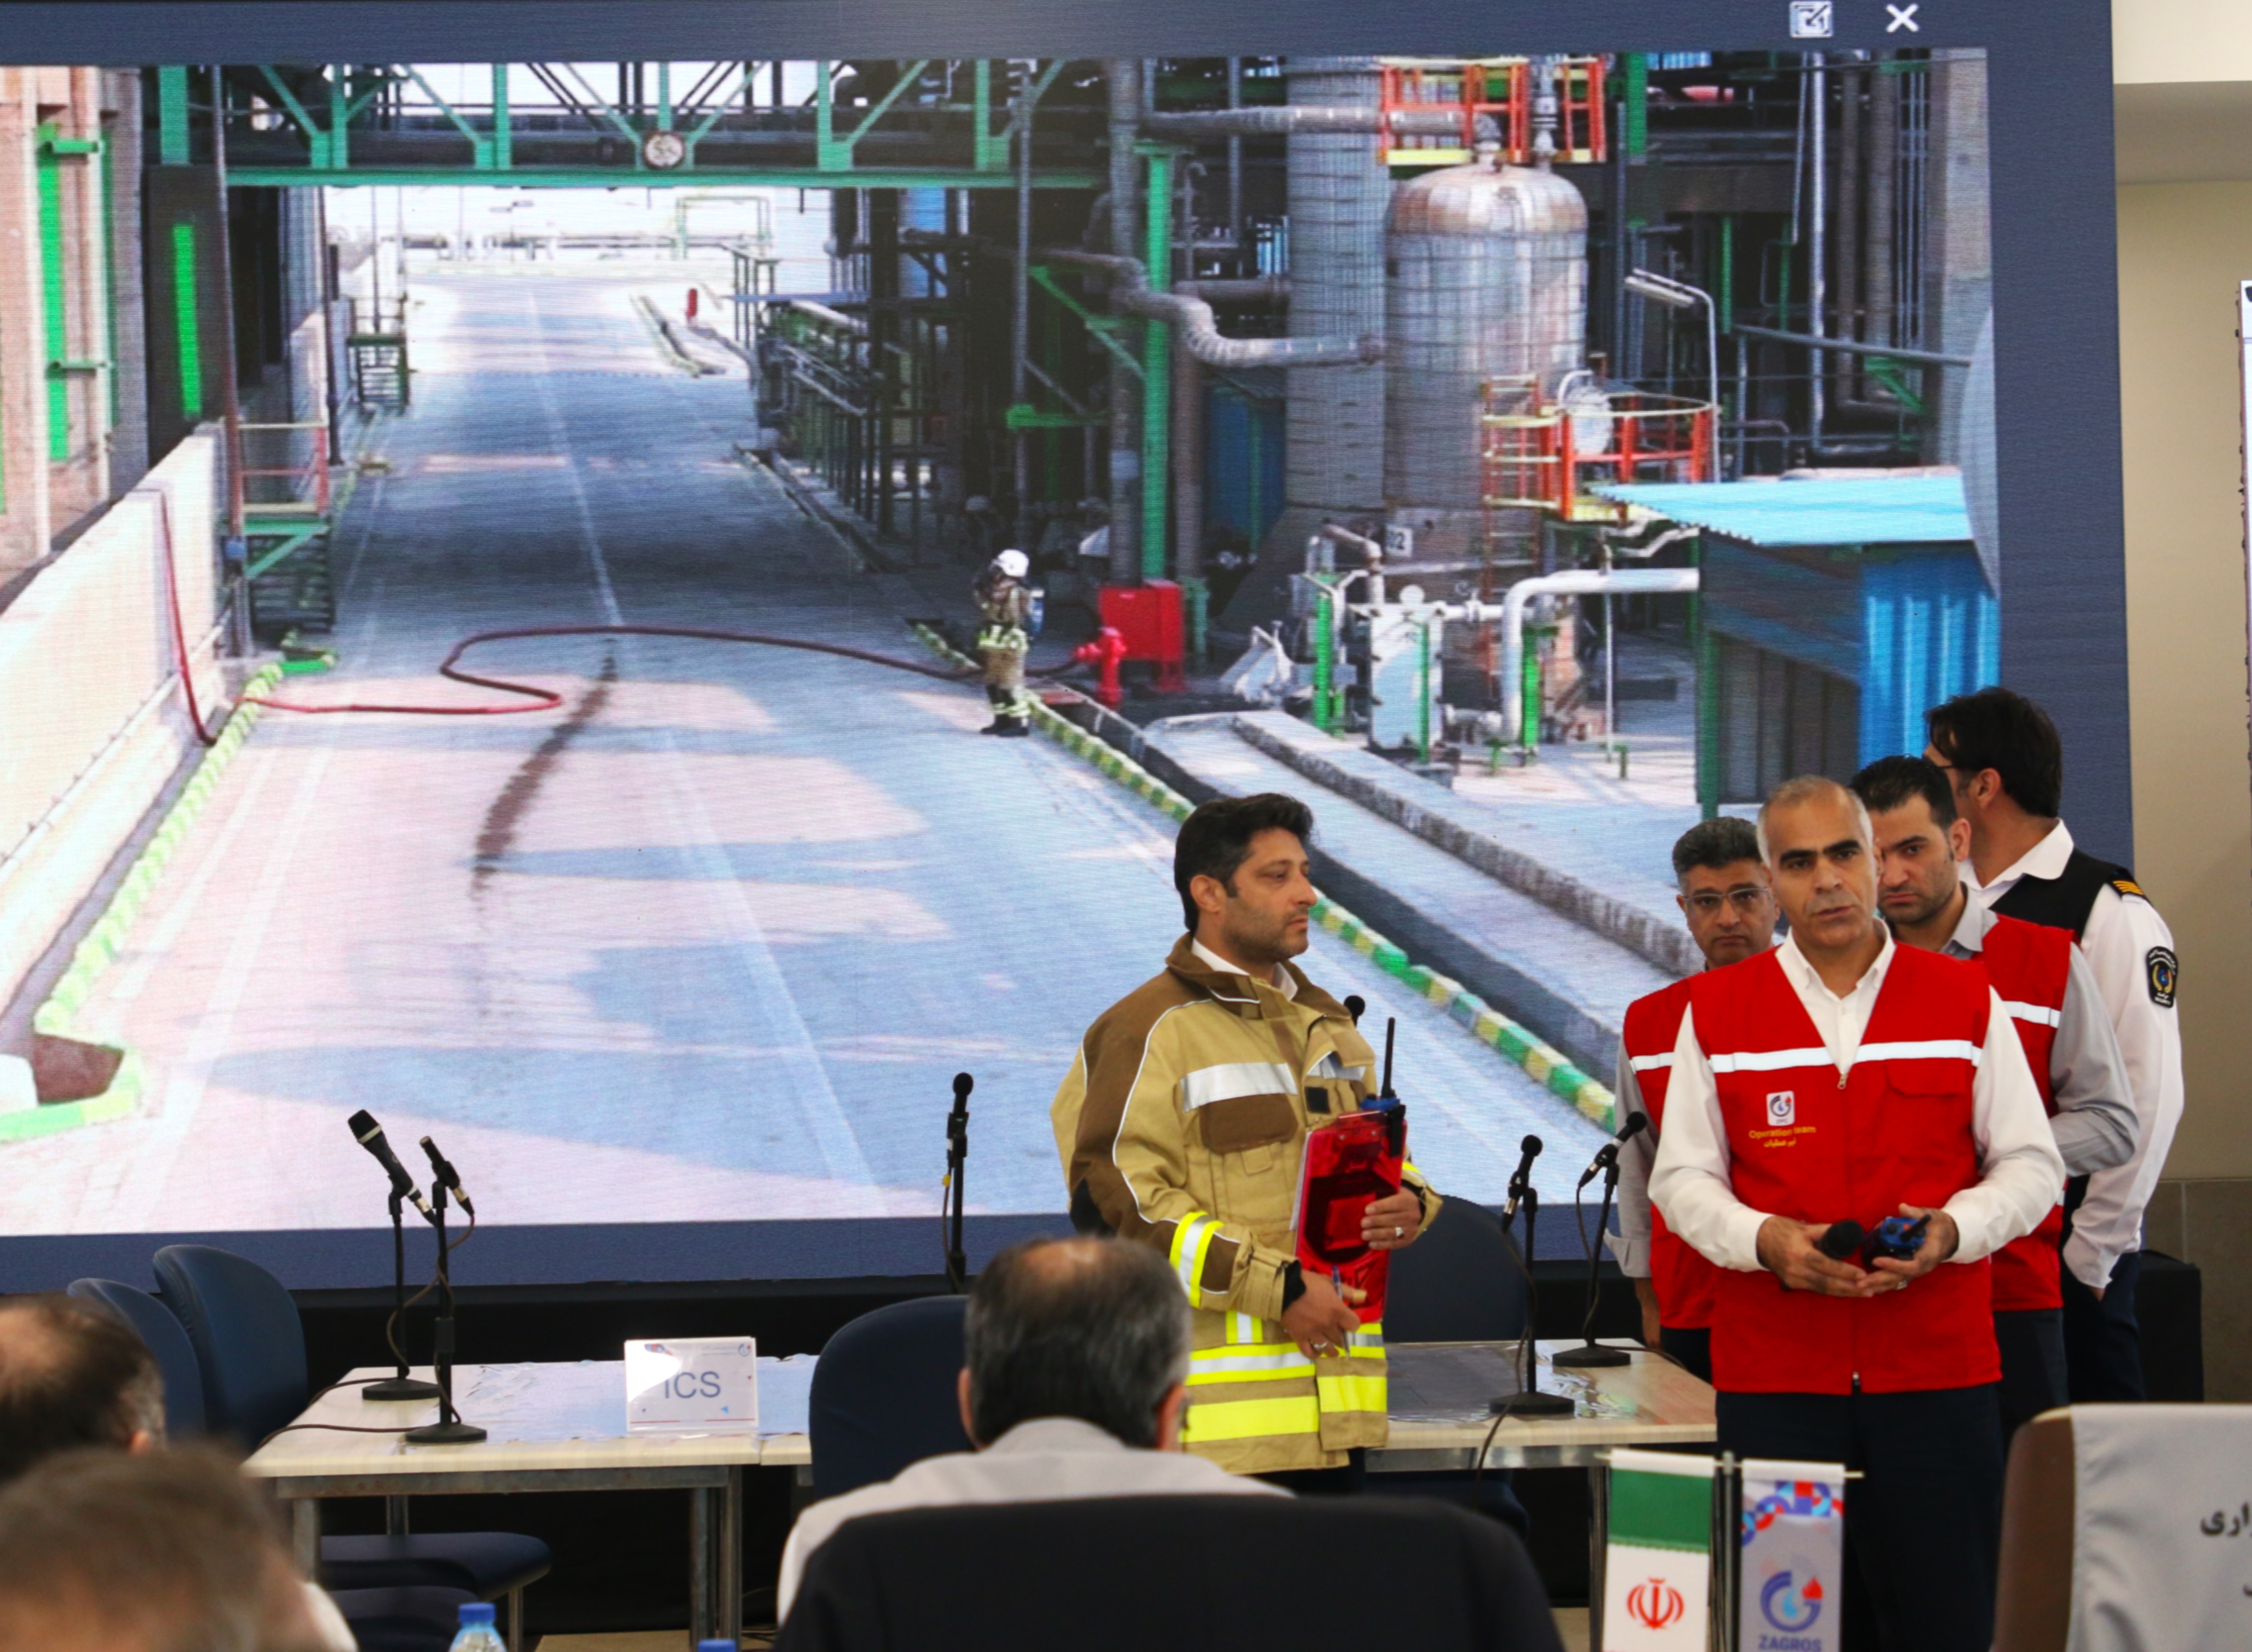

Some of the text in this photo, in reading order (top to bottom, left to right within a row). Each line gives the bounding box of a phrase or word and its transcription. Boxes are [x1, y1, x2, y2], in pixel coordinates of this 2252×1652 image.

[1749, 1129, 1792, 1139] Operation
[665, 1371, 721, 1399] ICS
[2200, 1501, 2252, 1537] اری
[1759, 1635, 1821, 1652] ZAGROS
